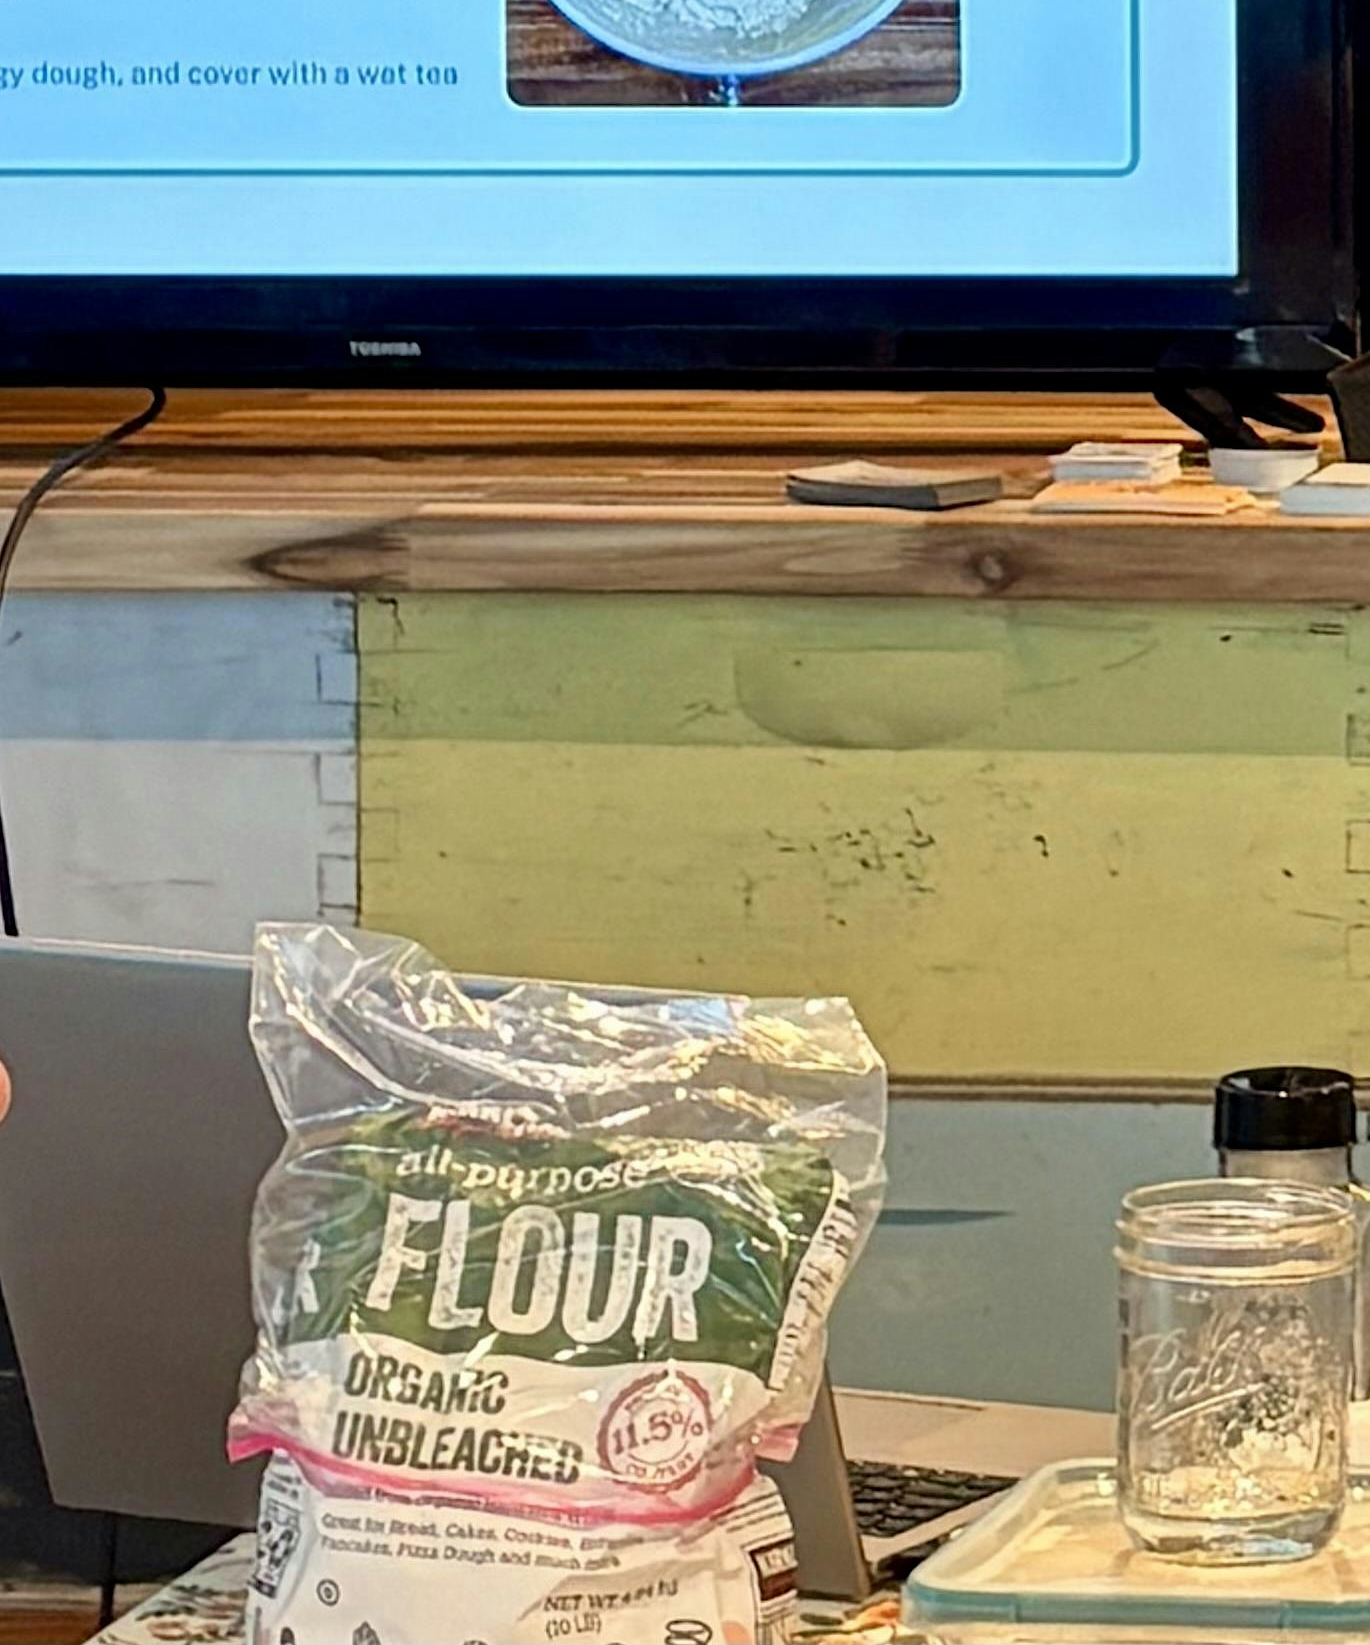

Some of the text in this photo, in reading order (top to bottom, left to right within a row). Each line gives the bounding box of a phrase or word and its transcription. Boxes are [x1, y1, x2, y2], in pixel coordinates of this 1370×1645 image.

[32, 60, 123, 90] dough,
[132, 61, 179, 85] and
[188, 65, 261, 85] cover
[268, 60, 327, 86] with
[334, 67, 349, 85] a
[357, 63, 406, 85] wet
[416, 64, 458, 85] tea
[349, 341, 422, 356] TOSHIBA
[396, 1145, 648, 1199] all-purpose
[366, 1192, 713, 1344] FLOUR
[344, 1352, 508, 1415] ORGANIC
[333, 1411, 584, 1484] UNBLEACHED
[612, 1407, 704, 1456] 11.5%
[500, 1551, 531, 1566] and
[544, 1594, 583, 1612] NET
